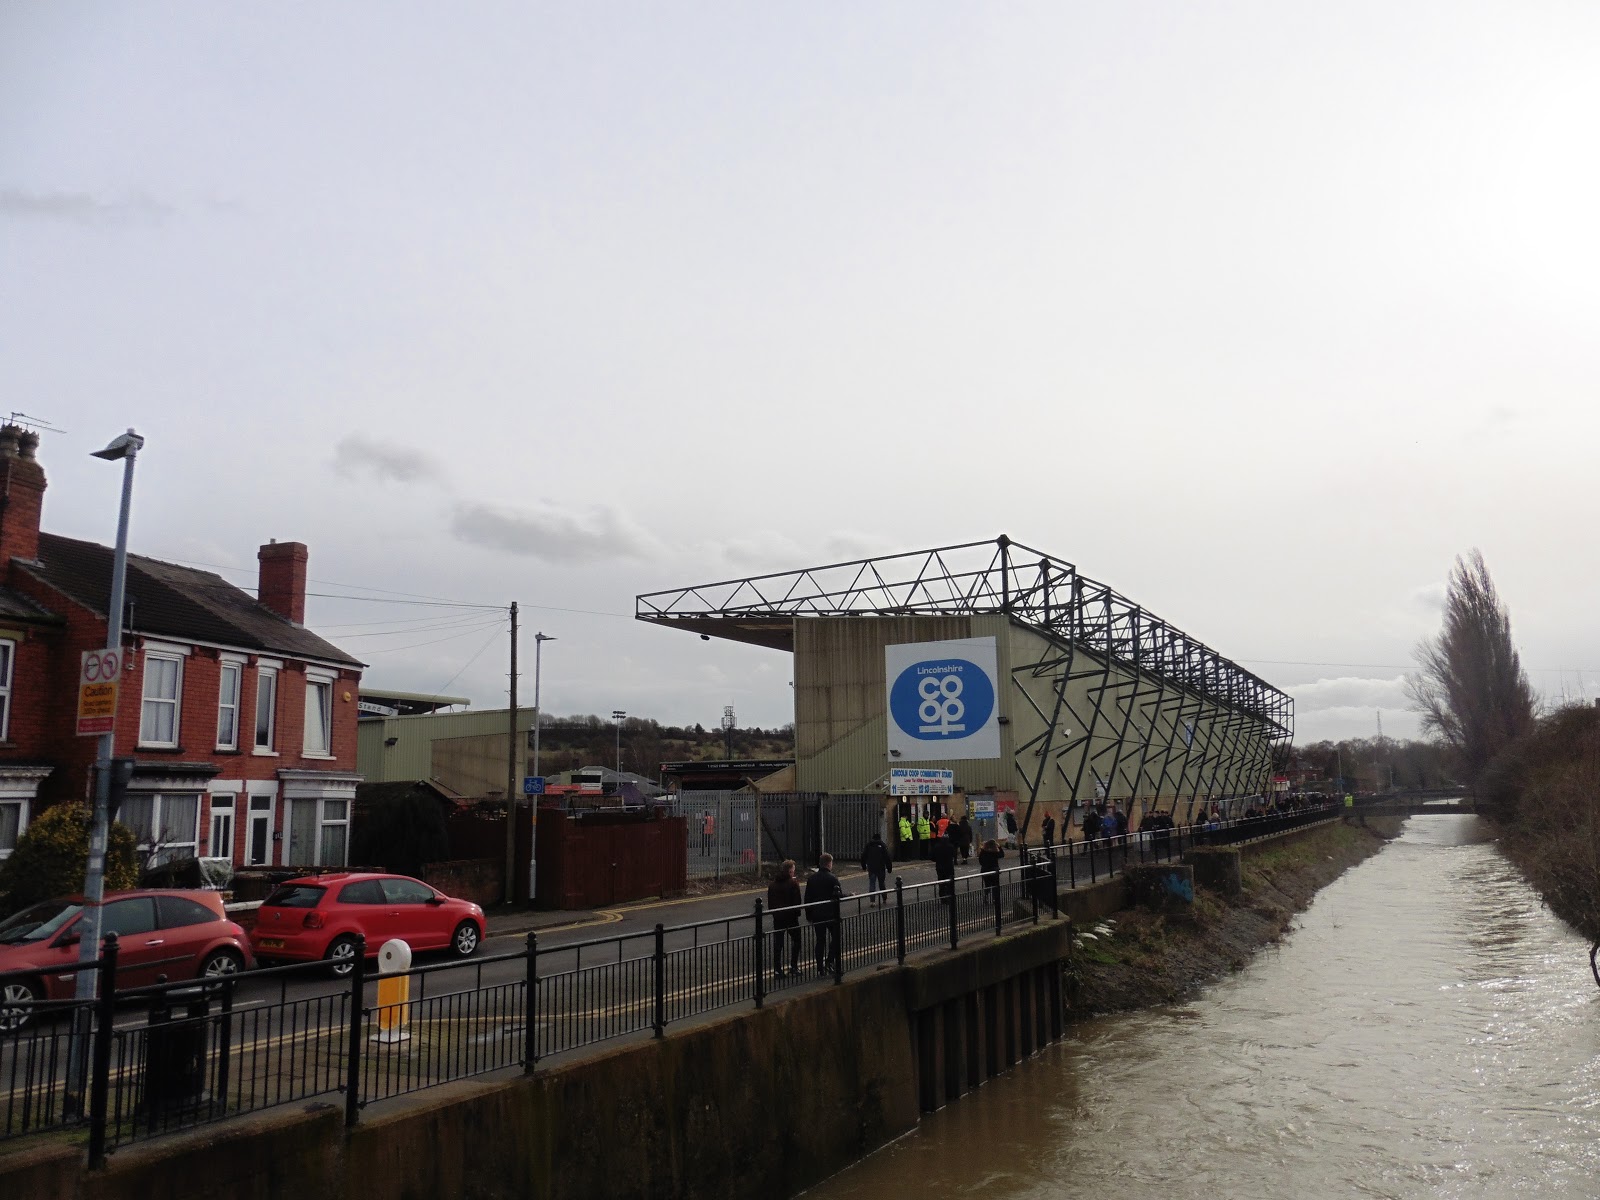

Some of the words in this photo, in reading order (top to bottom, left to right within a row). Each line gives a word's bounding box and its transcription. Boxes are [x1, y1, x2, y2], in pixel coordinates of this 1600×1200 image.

[917, 665, 963, 675] Lincolnshire
[84, 686, 112, 697] Caution
[358, 703, 381, 712] Stand
[920, 770, 940, 778] COMMUNITY
